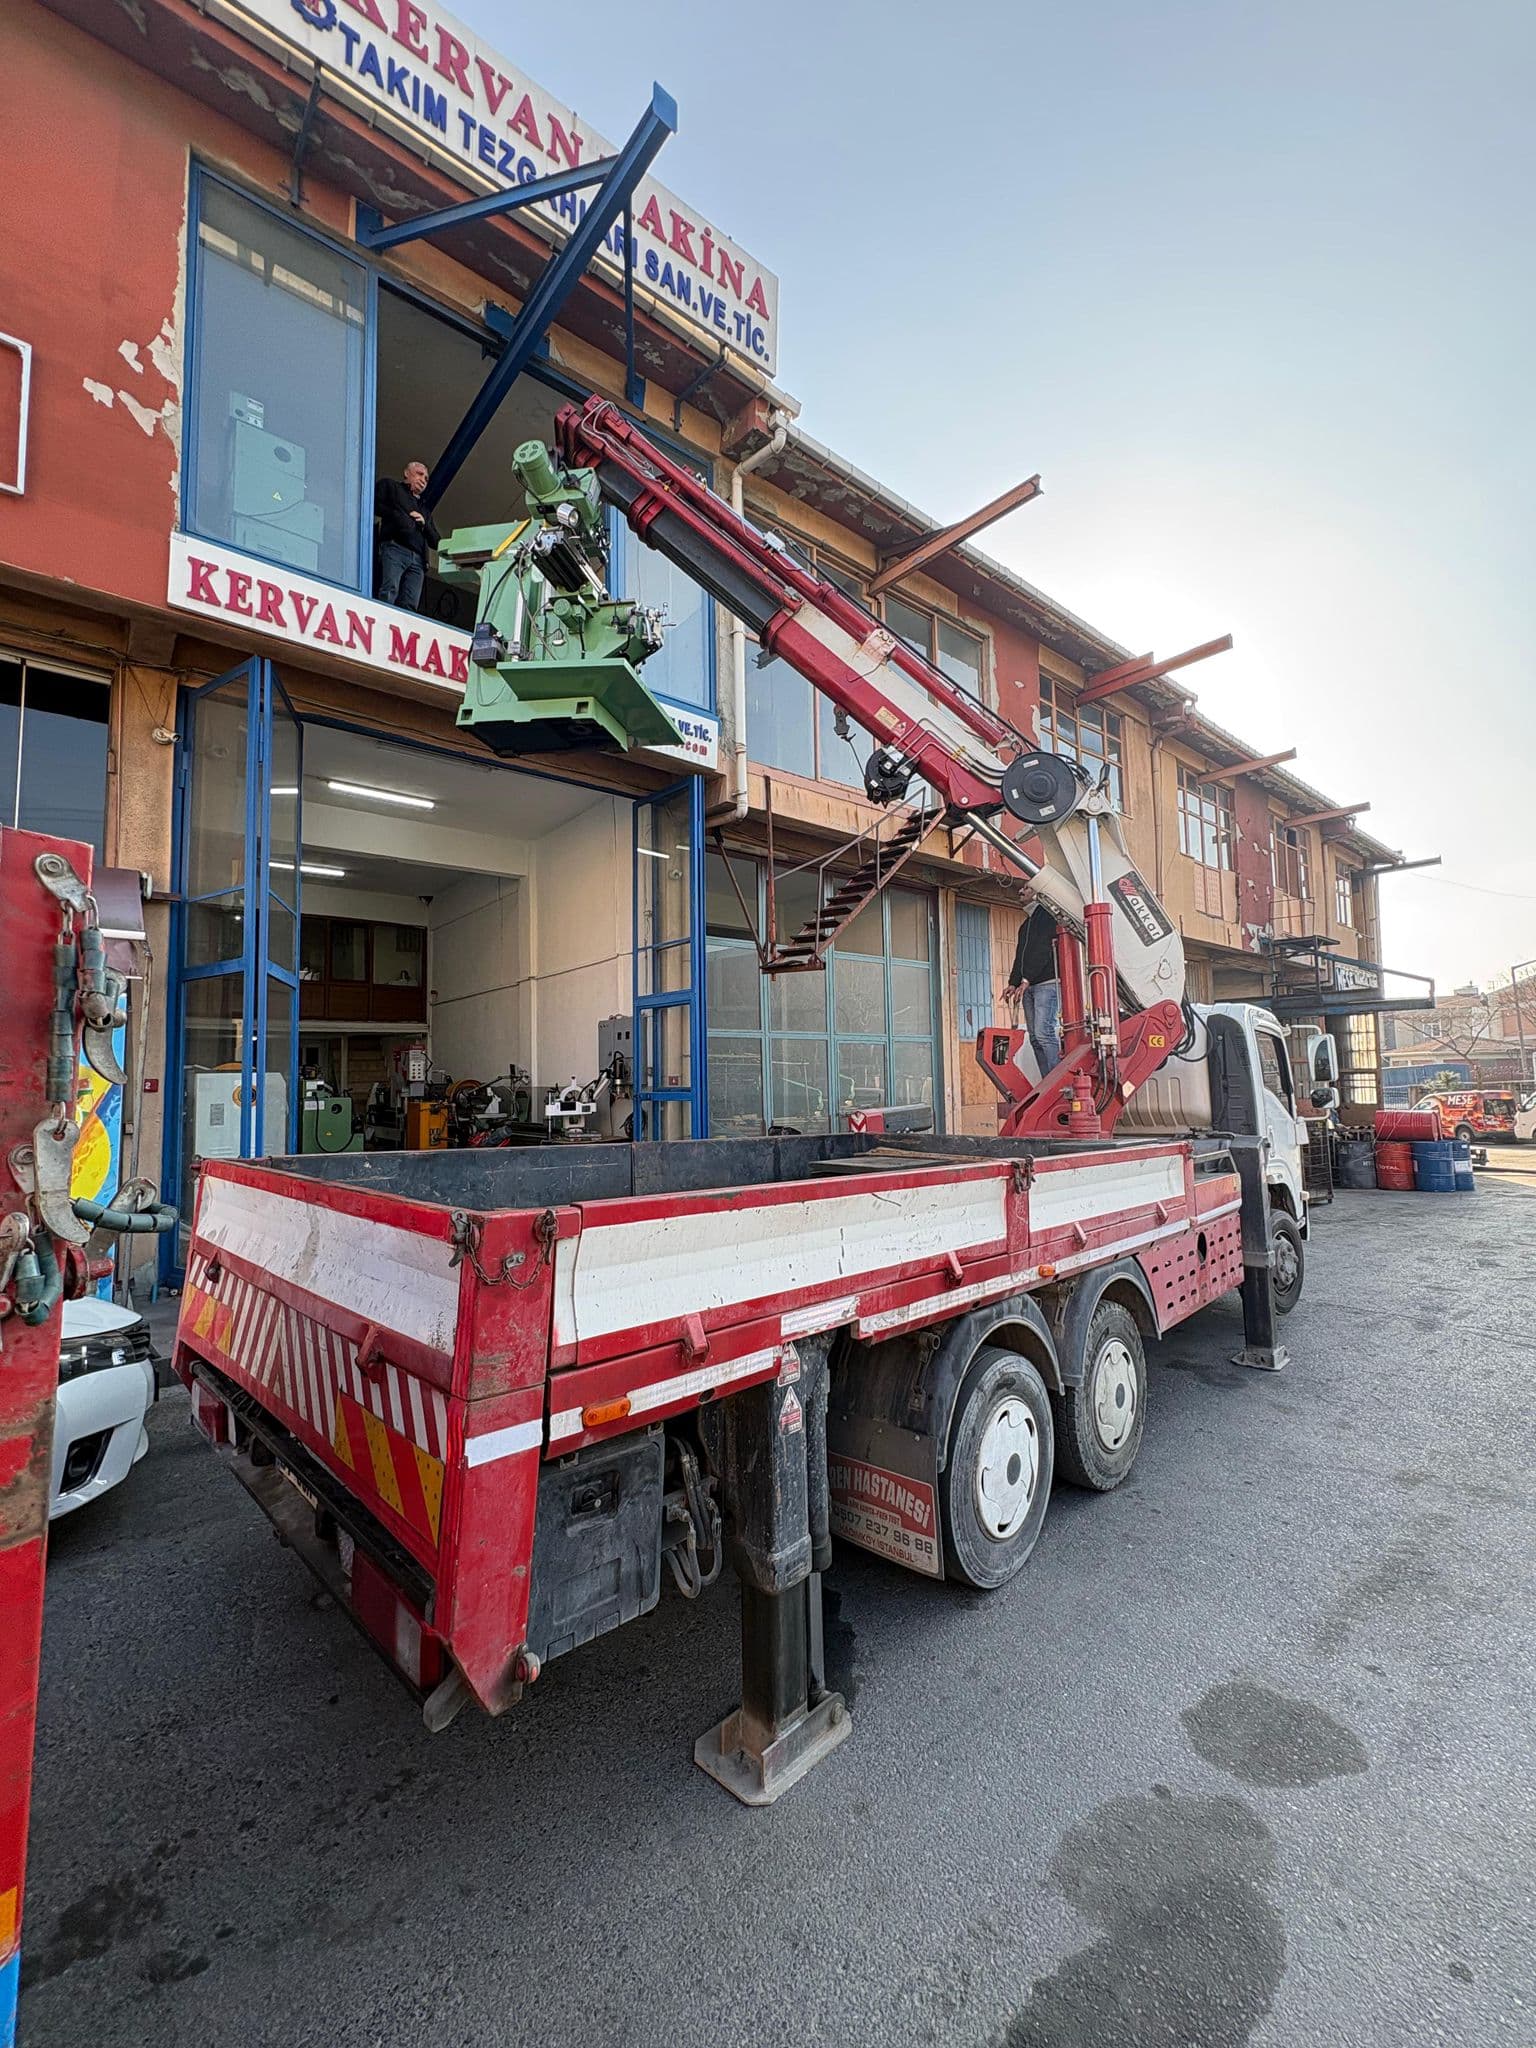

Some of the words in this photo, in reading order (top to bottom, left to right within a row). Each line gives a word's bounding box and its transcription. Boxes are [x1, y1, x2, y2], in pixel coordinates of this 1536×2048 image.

[338, 20, 447, 134] TAKIM
[458, 108, 638, 269] TEZGHRI
[599, 153, 770, 321] AKİNA
[186, 555, 376, 655] KERVAN
[865, 1518, 889, 1537] 237
[893, 1529, 910, 1547] 96
[915, 1539, 933, 1555] 88
